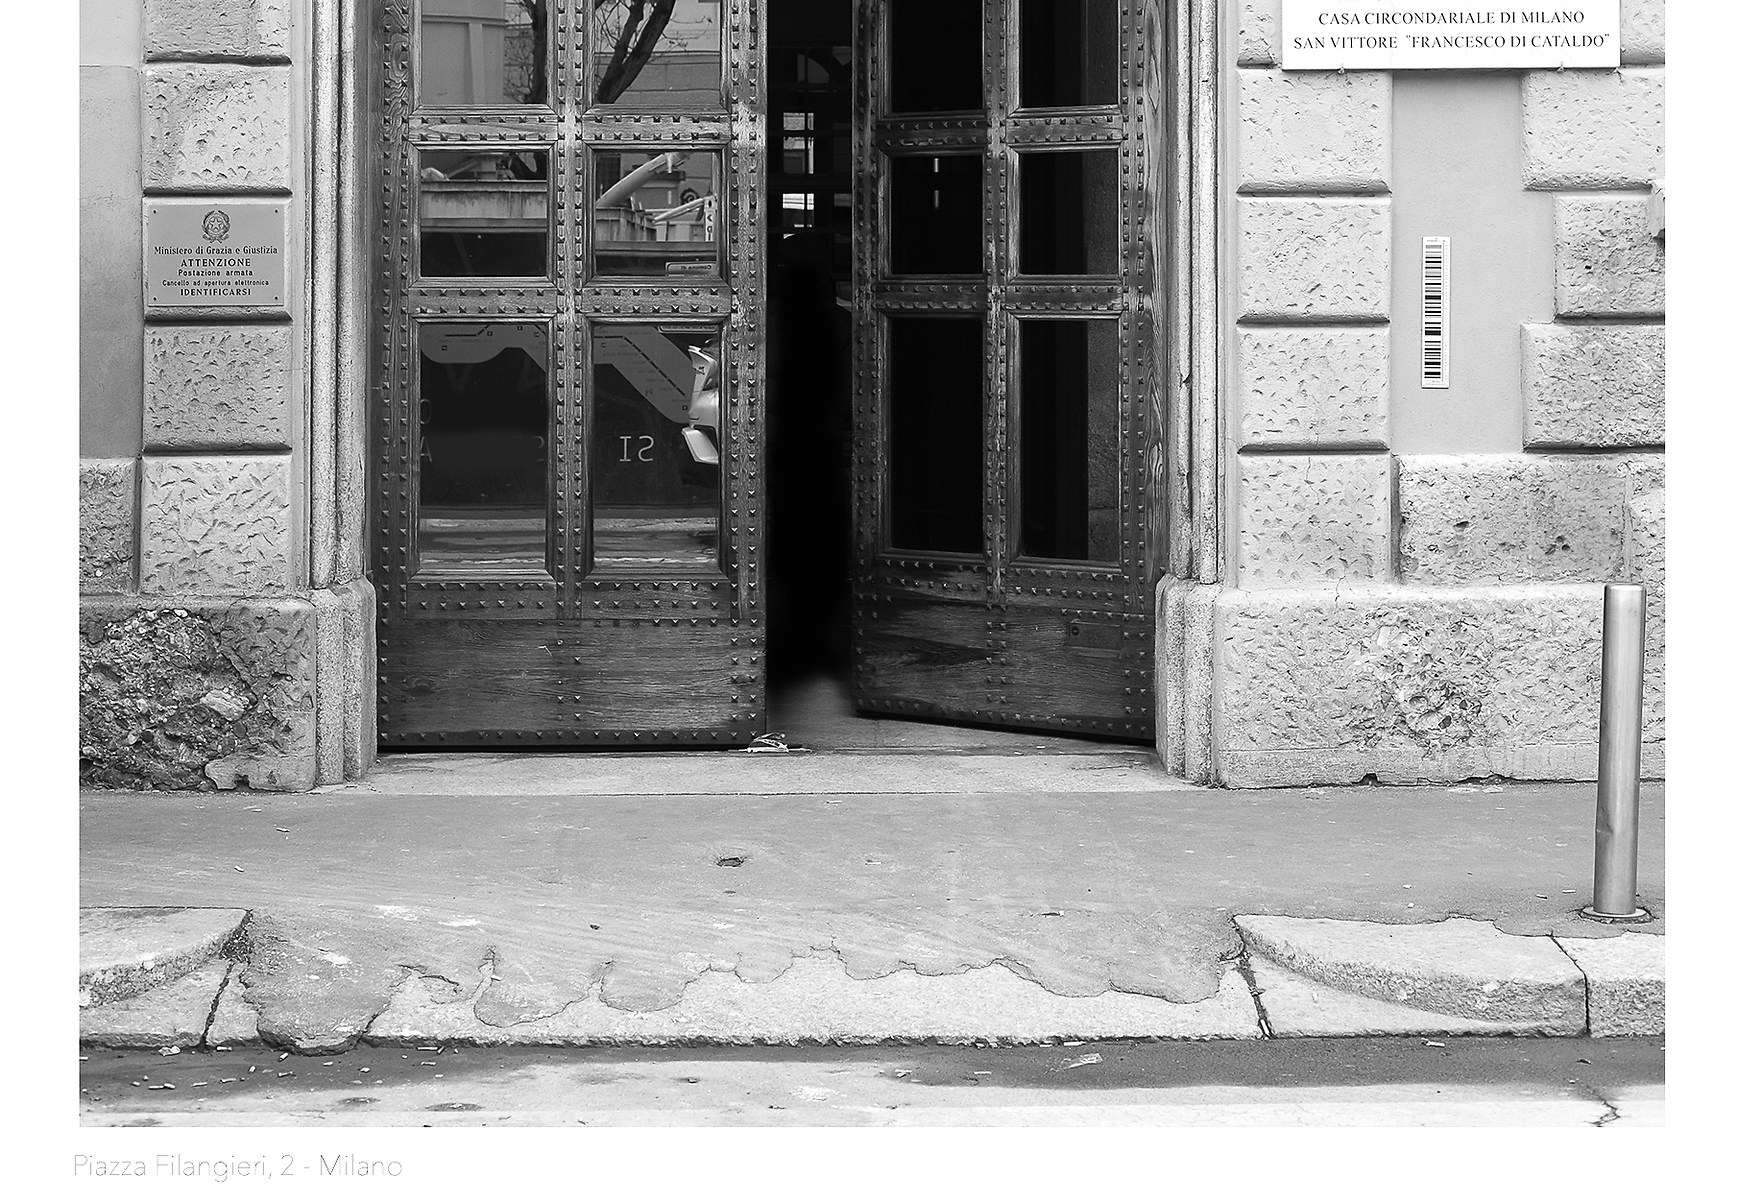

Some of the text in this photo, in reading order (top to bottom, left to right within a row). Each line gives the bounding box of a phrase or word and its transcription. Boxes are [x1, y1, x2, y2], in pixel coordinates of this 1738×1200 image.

[1318, 11, 1585, 26] CASA CIRCONDARIALE DI MILANO
[1293, 33, 1610, 50] SAN VITTORE "FRANCESCO DI CATALDO"
[154, 245, 278, 255] Ministero di Grazia e Giustizia
[180, 257, 251, 268] ATTENZIONE
[177, 268, 253, 277] Postazione armata
[162, 279, 270, 288] Cancello ad apertura elettronica
[180, 287, 251, 297] IDENTIFICARSI
